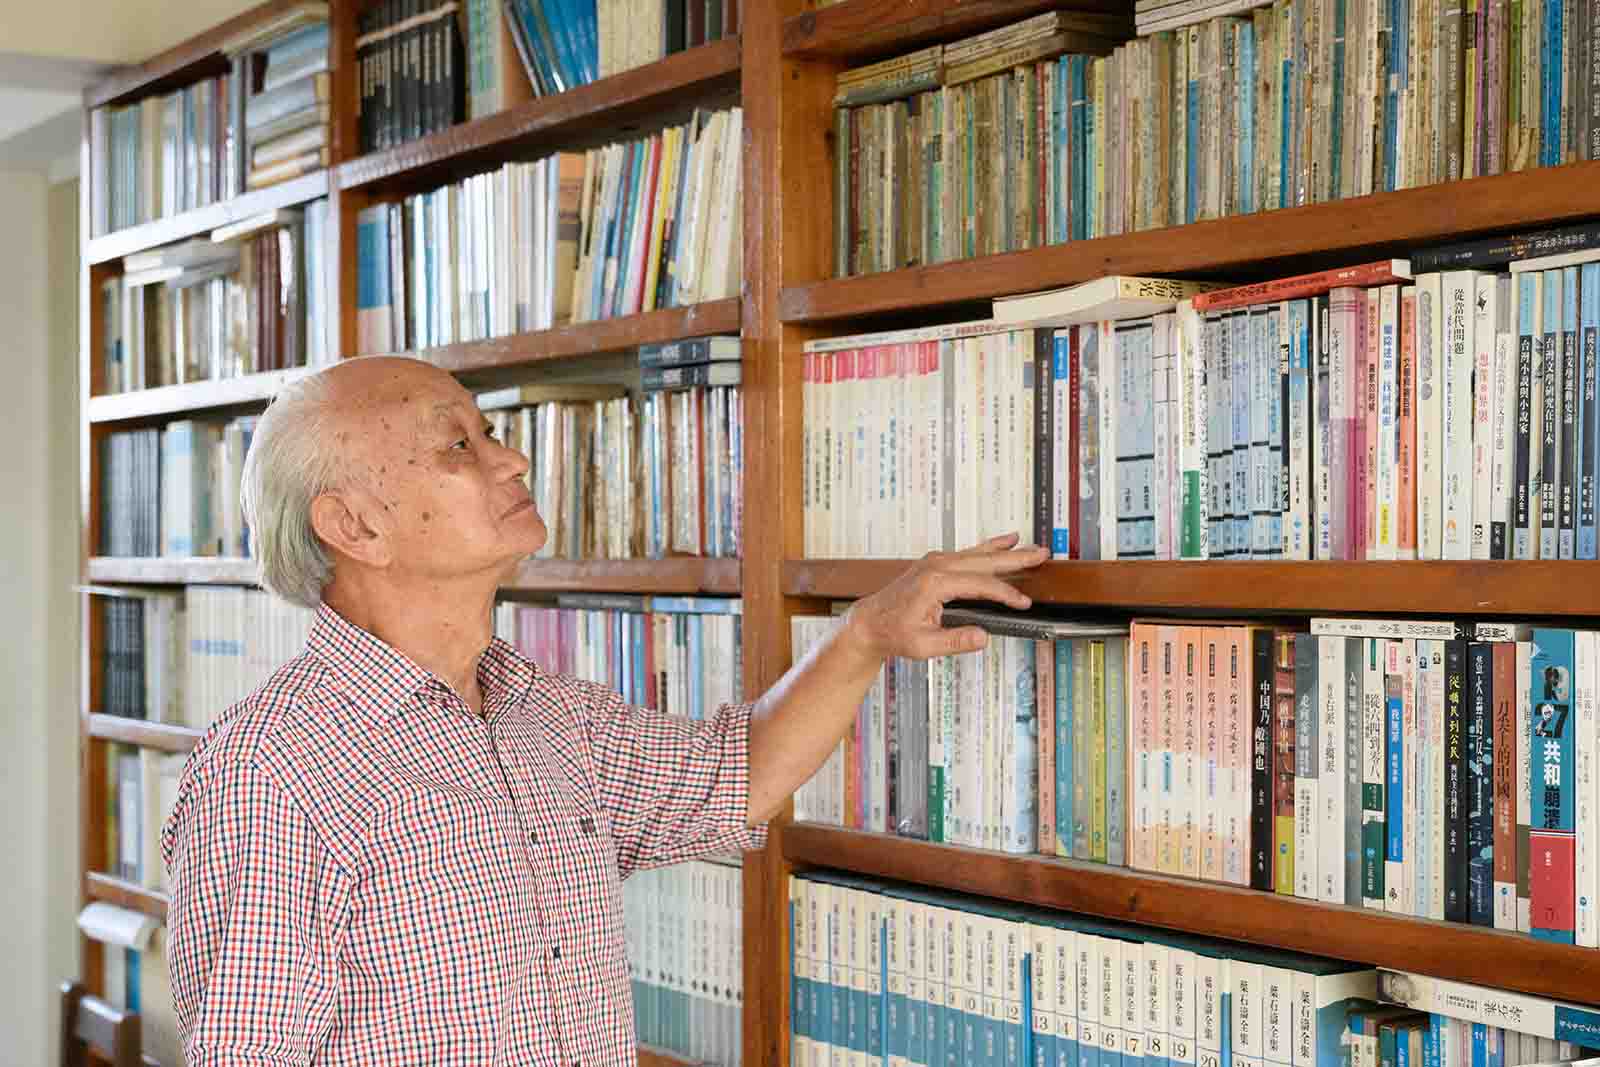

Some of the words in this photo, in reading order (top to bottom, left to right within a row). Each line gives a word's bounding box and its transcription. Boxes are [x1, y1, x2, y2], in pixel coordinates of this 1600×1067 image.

[1519, 338, 1530, 433] 台灣小說與小說家
[1544, 337, 1555, 445] 台灣文學研究在日本
[1034, 1016, 1048, 1031] 13
[1079, 1026, 1092, 1042] 15
[1101, 1032, 1115, 1048] 16
[1125, 1037, 1139, 1053] 17
[1145, 1037, 1161, 1053] 18
[1172, 1042, 1187, 1058] 19
